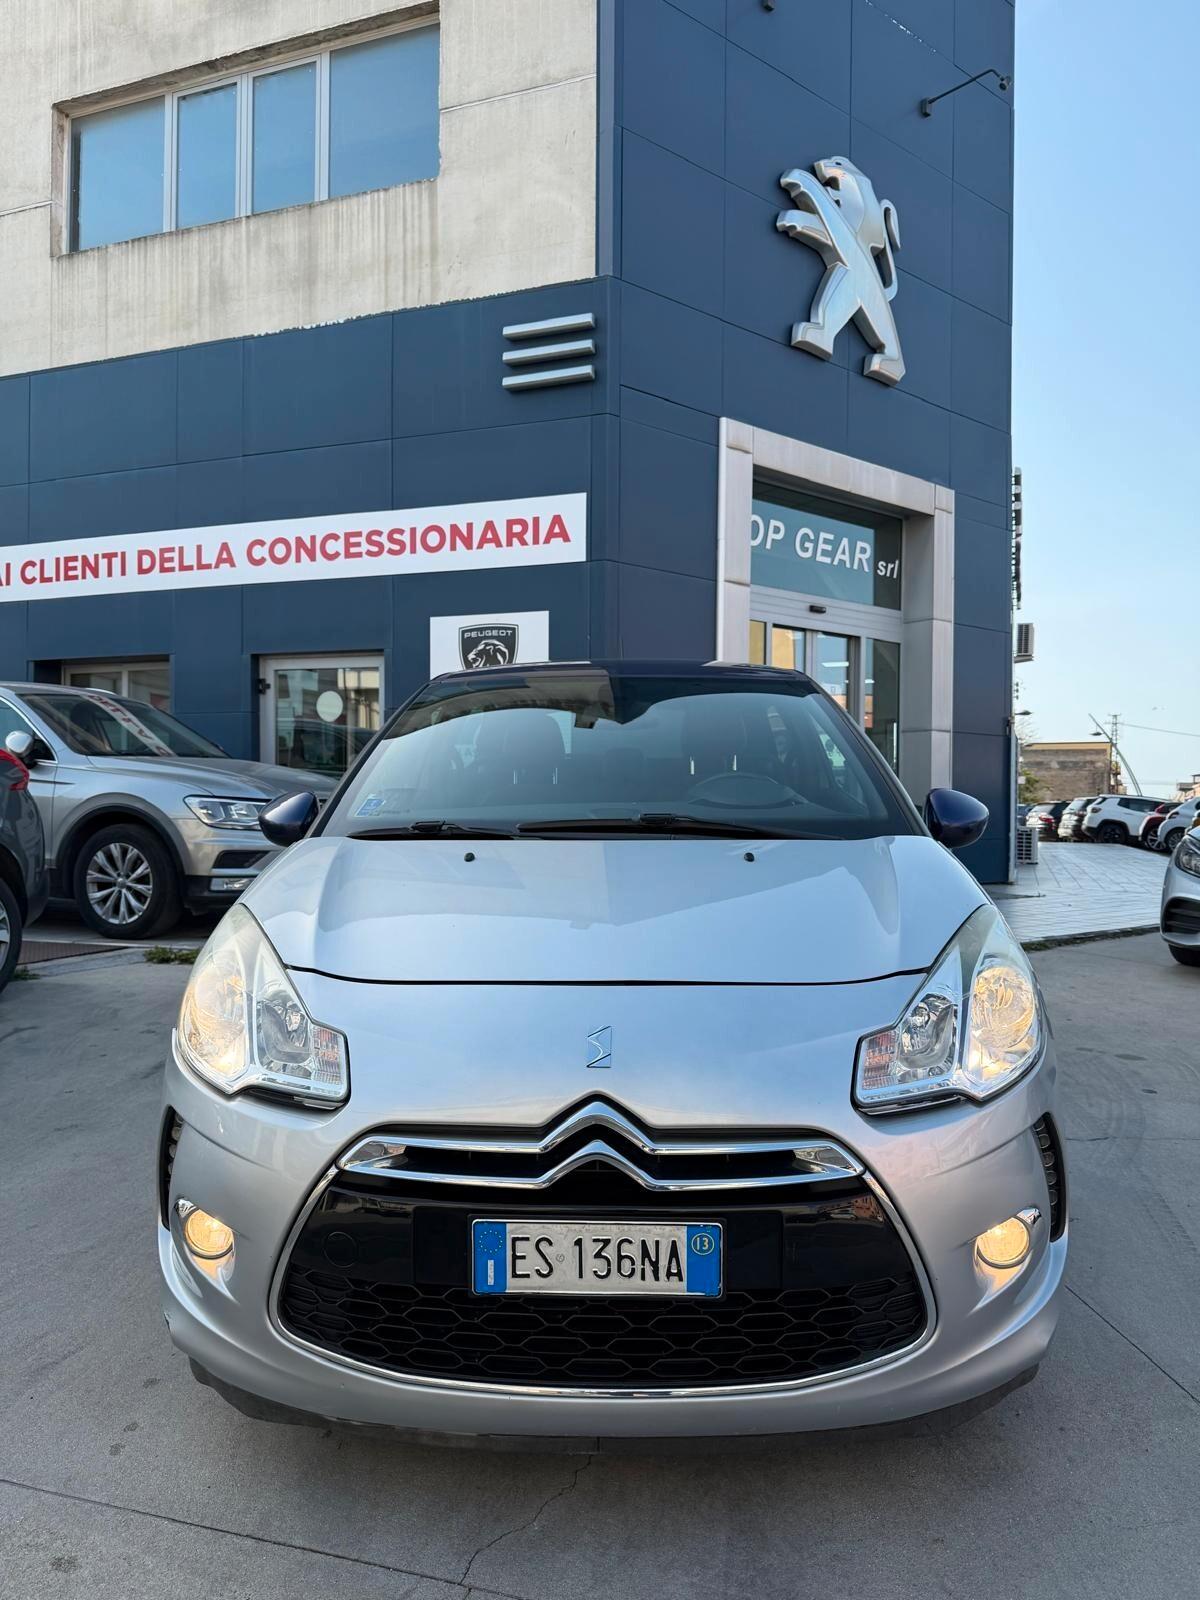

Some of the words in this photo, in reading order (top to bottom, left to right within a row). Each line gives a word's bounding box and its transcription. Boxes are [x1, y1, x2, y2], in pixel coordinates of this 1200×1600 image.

[0, 562, 11, 587] I
[20, 551, 127, 585] CLIENTI
[137, 542, 237, 575] DELLA
[246, 514, 571, 567] CONCESSIONARIA
[795, 527, 872, 572] GEAR
[876, 560, 899, 579] srl
[464, 629, 513, 638] PEUGEOT
[511, 1234, 553, 1278] ES
[573, 1236, 684, 1282] 136NA
[695, 1237, 709, 1251] 13
